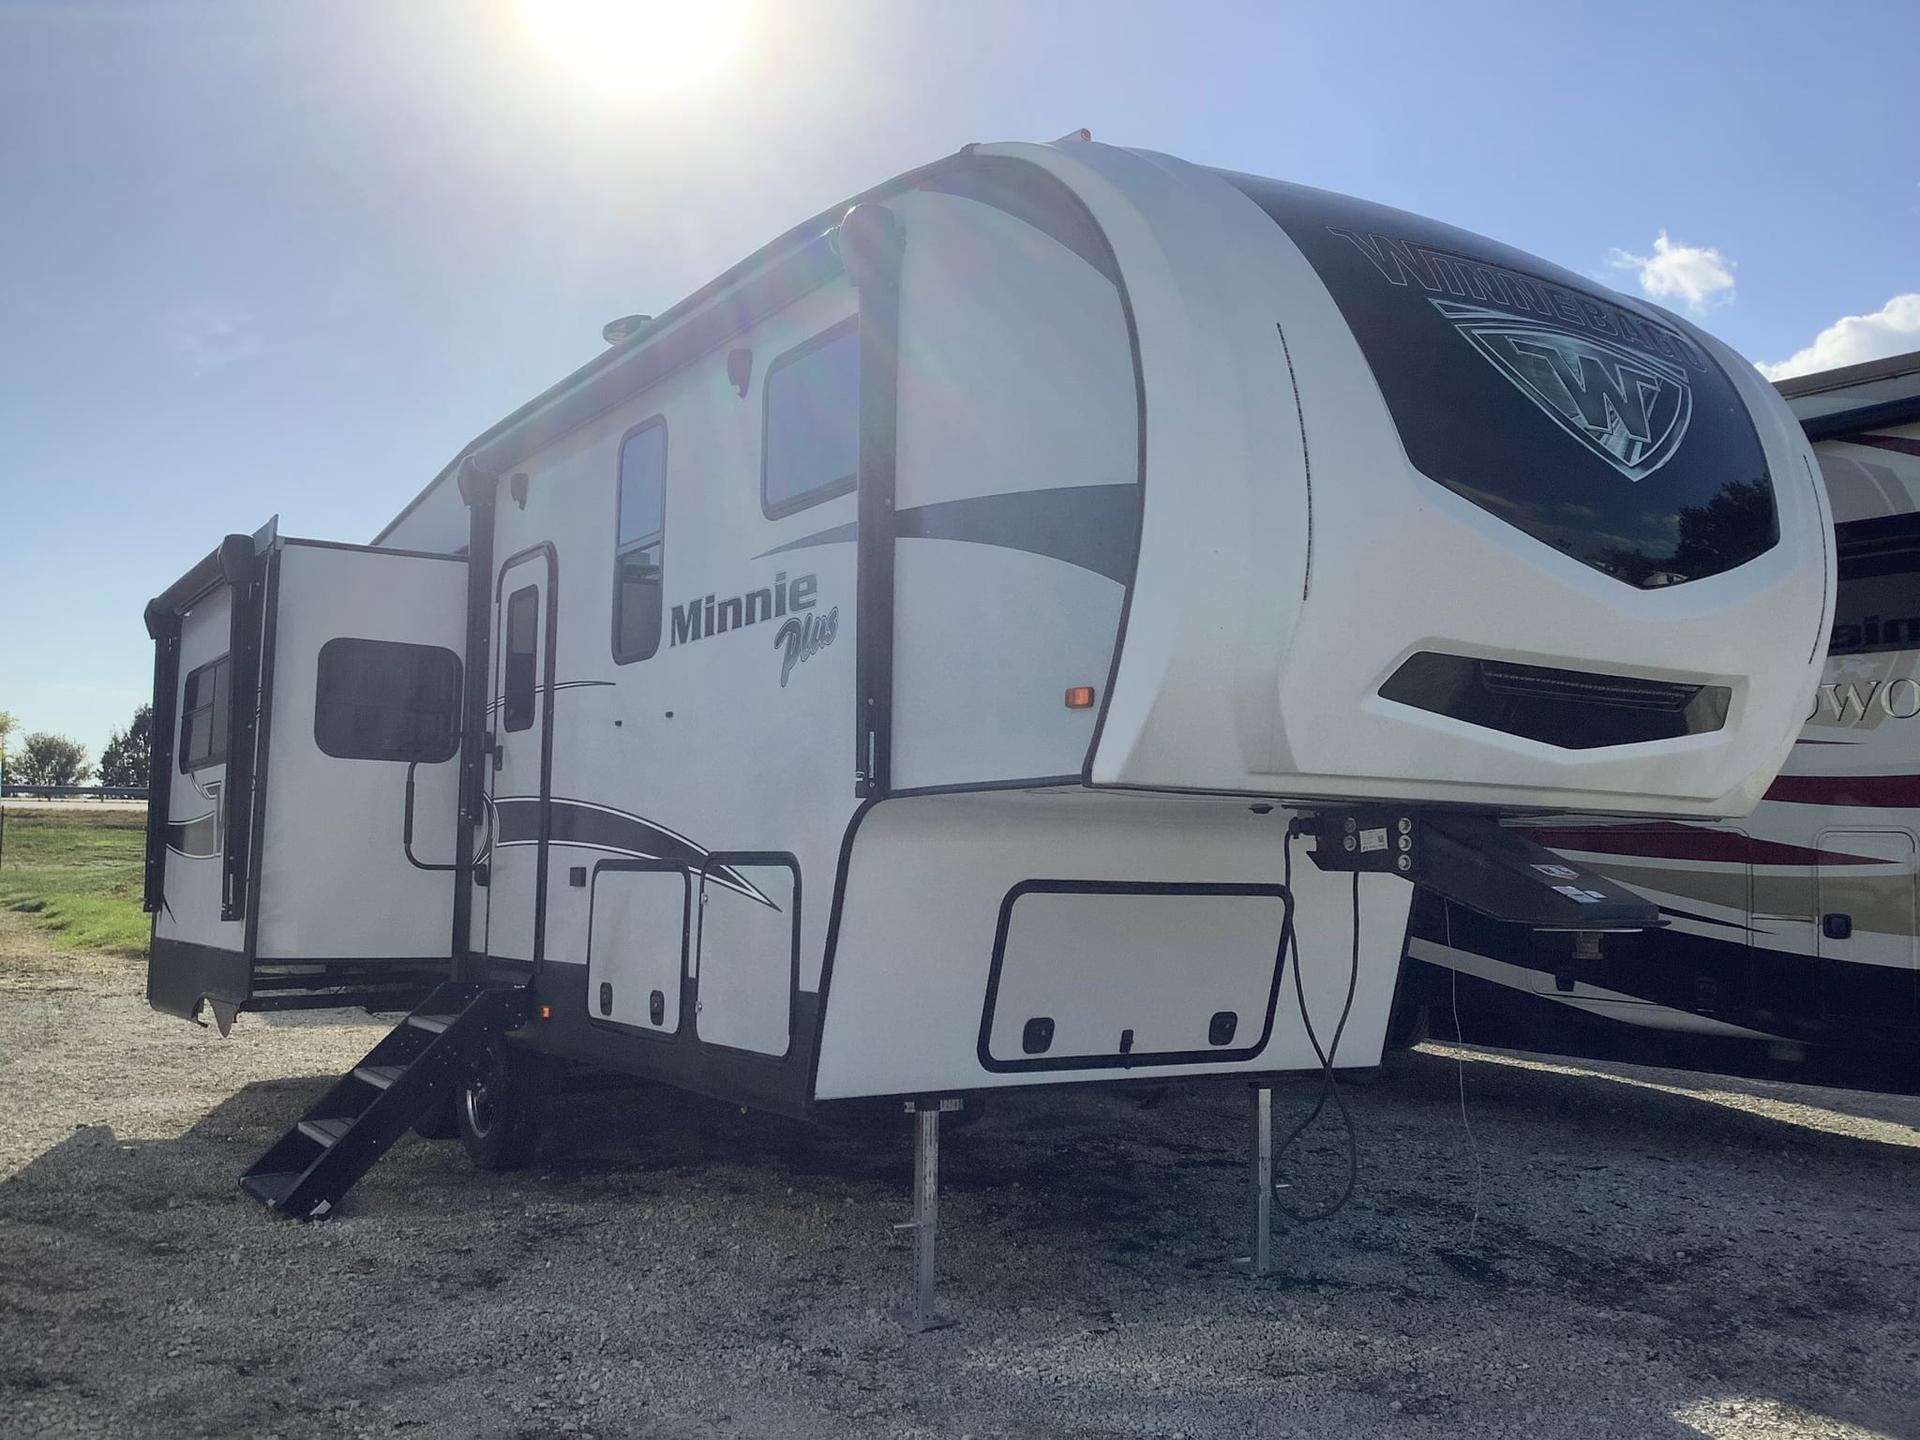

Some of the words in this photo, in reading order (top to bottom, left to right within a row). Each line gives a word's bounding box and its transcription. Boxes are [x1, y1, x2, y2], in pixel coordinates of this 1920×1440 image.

[1504, 335, 1663, 443] W
[670, 571, 818, 648] Minnie
[773, 605, 840, 689] Plus
[1806, 678, 1920, 722] WO
